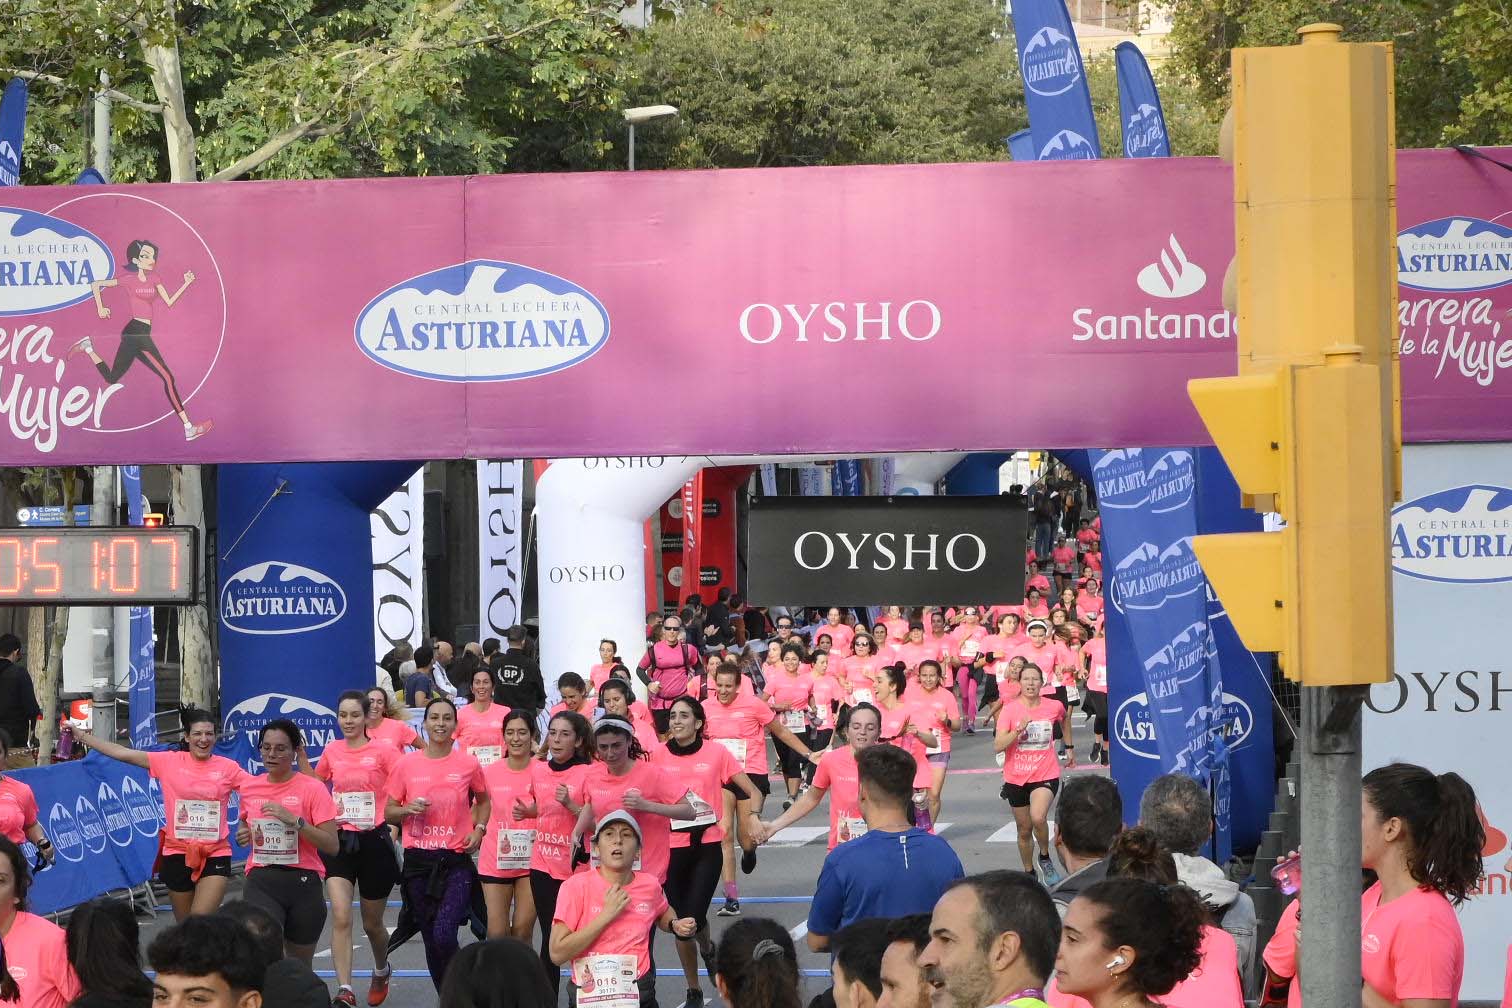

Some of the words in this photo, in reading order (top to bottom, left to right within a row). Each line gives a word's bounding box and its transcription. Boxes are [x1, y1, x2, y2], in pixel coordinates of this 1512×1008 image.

[17, 244, 90, 255] LECHERA
[1412, 243, 1462, 251] CENTRAL
[1398, 245, 1512, 273] ASTURIAN
[414, 303, 492, 316] CENTRAL
[500, 301, 583, 314] LECHERA
[1398, 297, 1493, 327] arrera
[374, 306, 590, 353] ASTURIANA
[739, 299, 942, 345] OYSHO
[1421, 328, 1439, 355] la
[1418, 520, 1486, 529] CENTRAL
[794, 531, 987, 572] OYSHO
[549, 564, 625, 584] OYSHO
[238, 587, 280, 595] CENTRAL
[284, 586, 333, 595] LECHERA
[224, 591, 338, 619] ASTURIANA
[504, 669, 518, 678] BP
[293, 718, 334, 726] ECHERA
